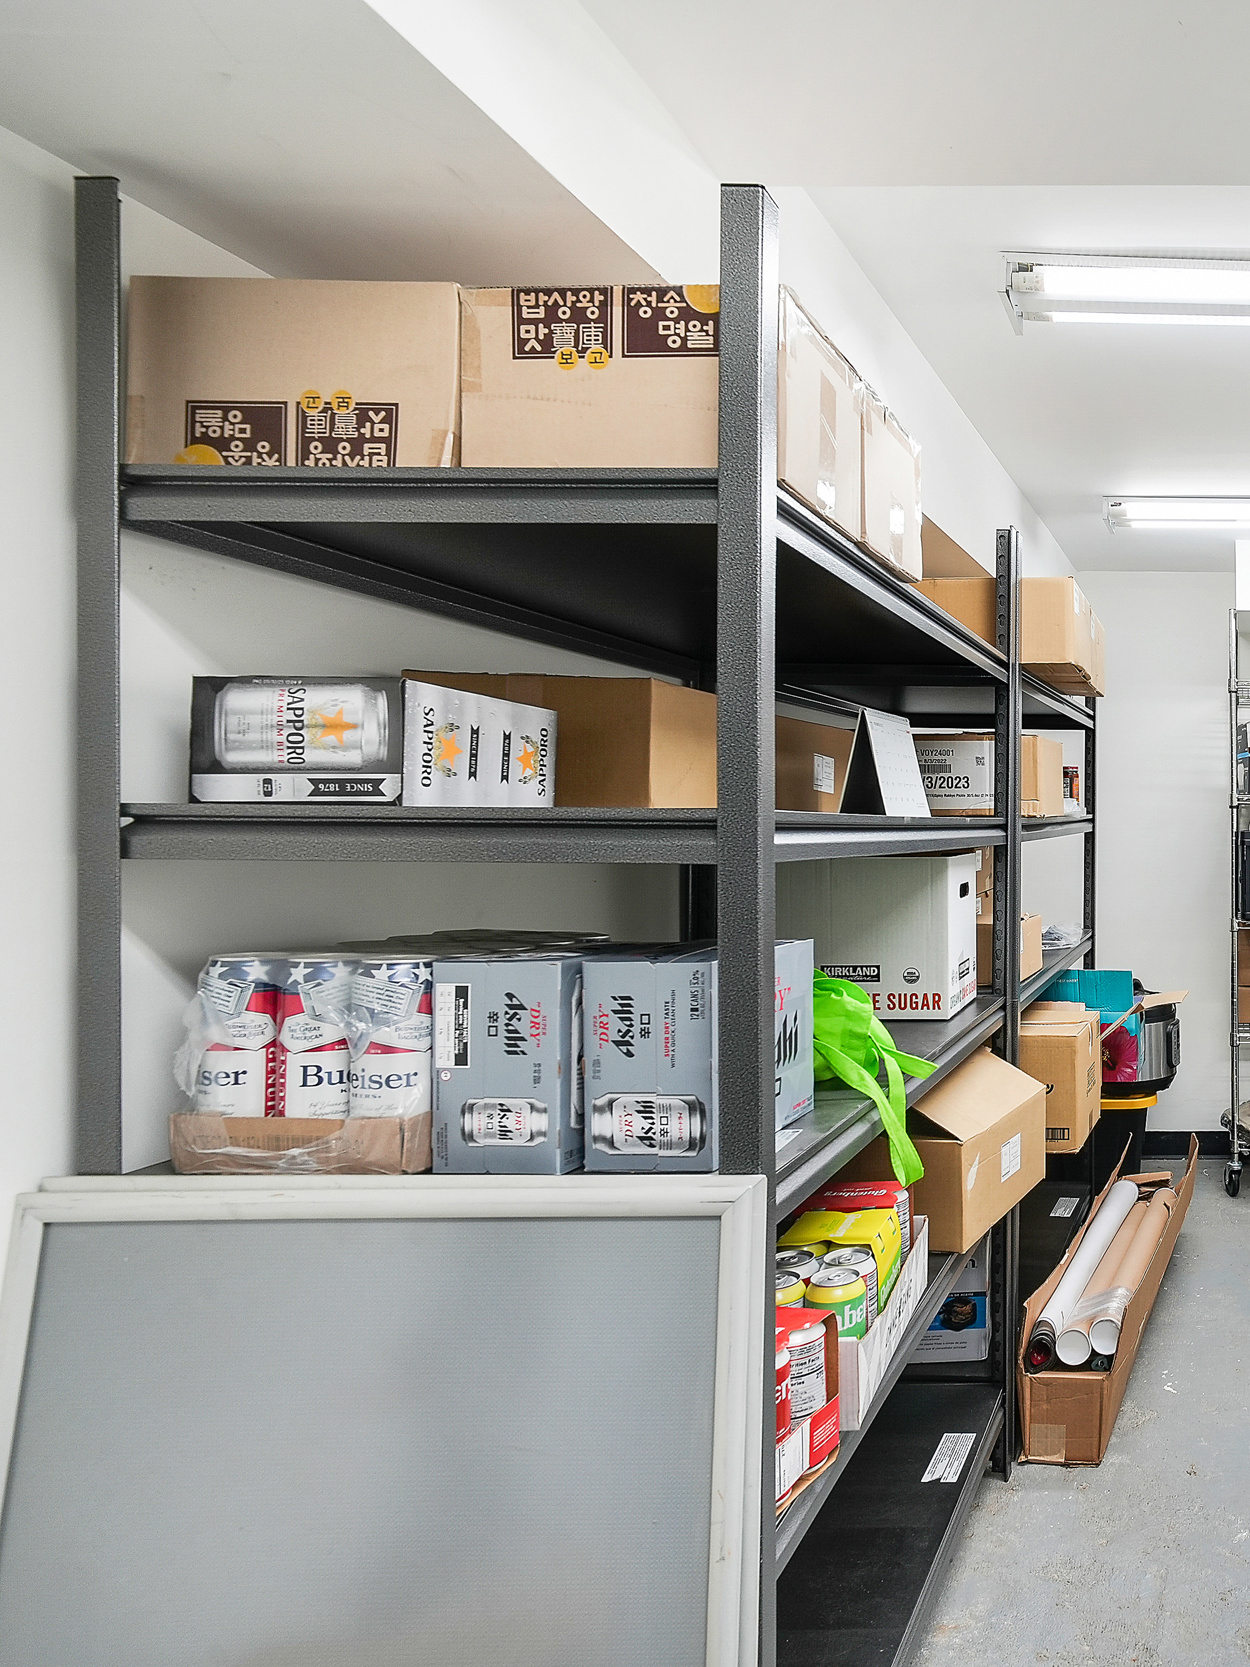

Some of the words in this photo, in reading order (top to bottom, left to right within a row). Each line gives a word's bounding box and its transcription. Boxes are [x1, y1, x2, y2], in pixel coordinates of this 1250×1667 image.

[519, 291, 604, 320] 밥상왕
[630, 291, 687, 319] 청송
[658, 320, 714, 349] 명월
[195, 410, 251, 438] 명월
[276, 688, 286, 736] PREMIUM
[286, 687, 306, 764] SAPPORO
[276, 741, 285, 763] BEER
[421, 706, 435, 787] SAPPORO
[920, 749, 954, 757] VOY24001
[537, 727, 549, 797] SAPPORO
[318, 783, 339, 792] 1876
[345, 783, 373, 792] SINCE
[824, 967, 878, 976] KIRKLAND
[690, 990, 699, 1006] CANS
[886, 992, 942, 1011] SUGAR
[487, 1011, 499, 1037] 辛口
[504, 992, 528, 1055] Asahi
[611, 995, 635, 1058] Asahi
[639, 1014, 651, 1039] 辛口
[197, 1069, 248, 1086] ser
[498, 1103, 513, 1140] Asahi
[634, 1100, 657, 1148] Asahi
[659, 1116, 669, 1138] 辛口
